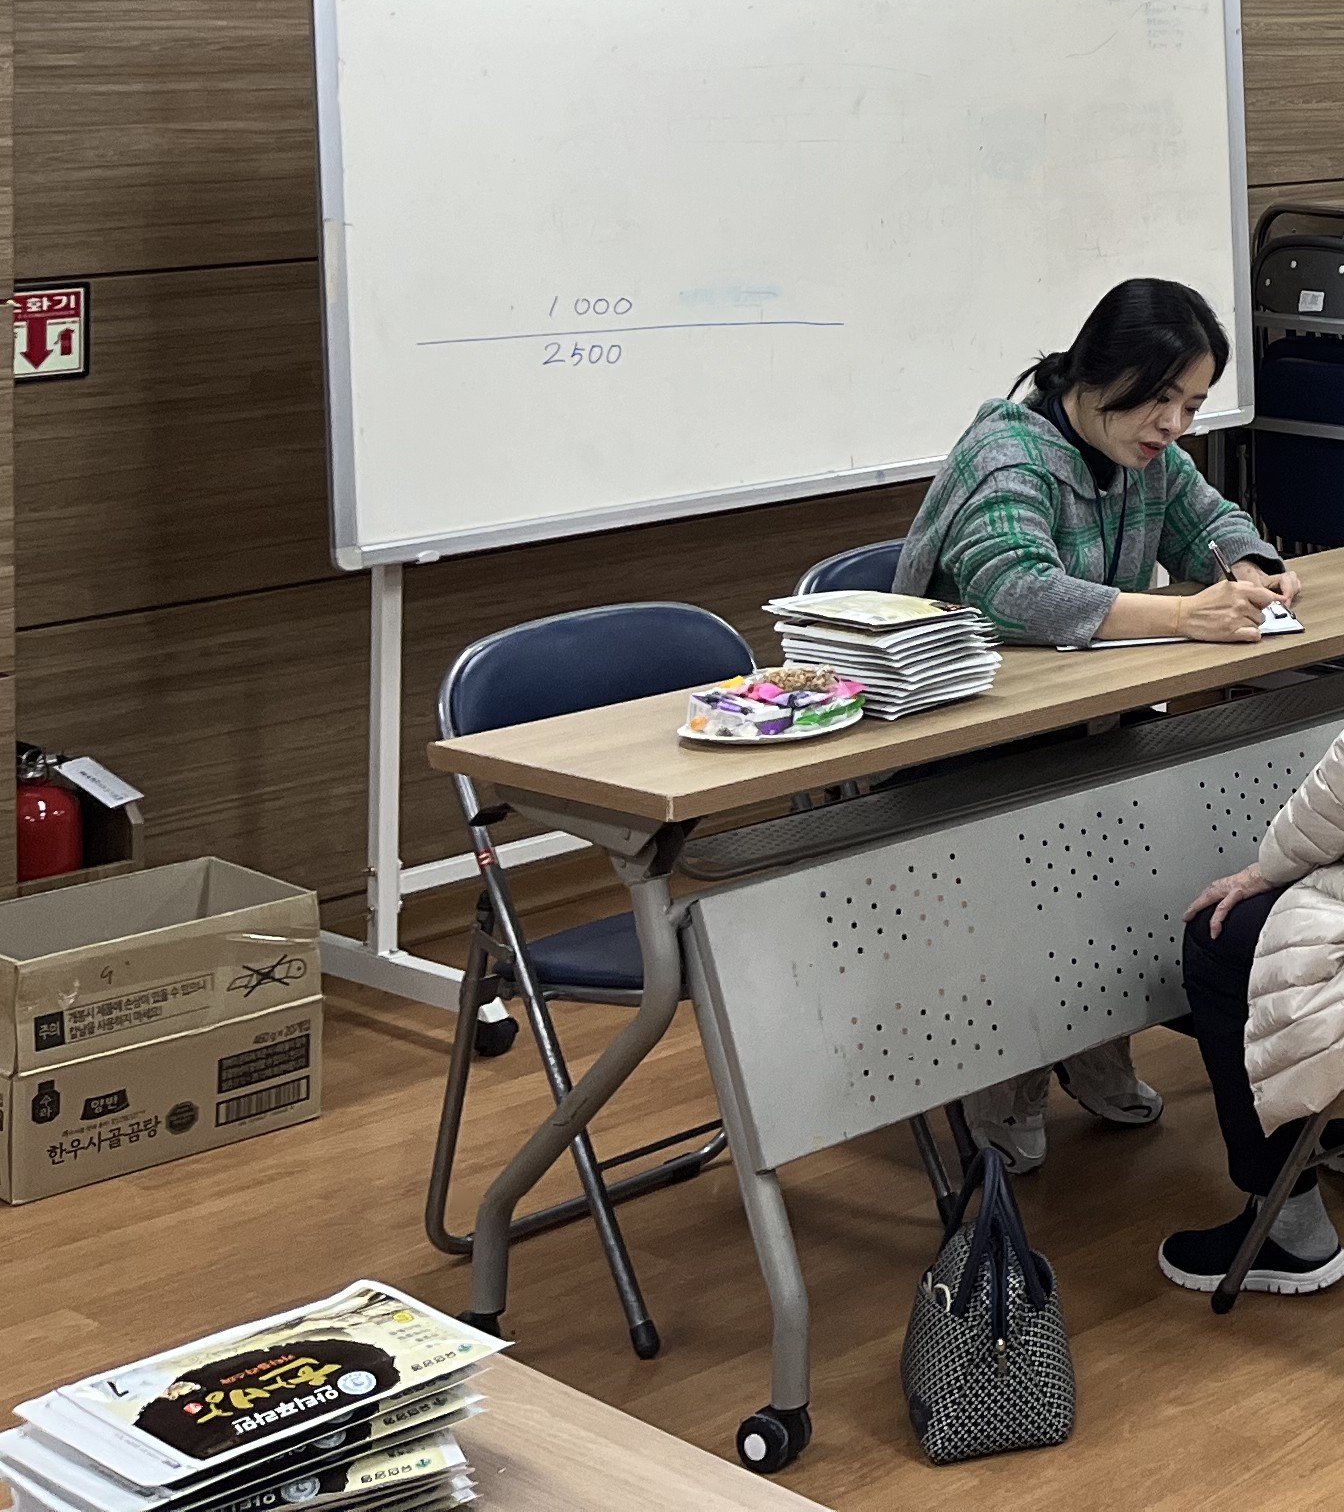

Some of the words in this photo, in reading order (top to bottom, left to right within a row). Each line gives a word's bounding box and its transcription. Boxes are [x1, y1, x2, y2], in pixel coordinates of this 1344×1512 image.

[548, 295, 633, 318] 1000
[542, 342, 623, 366] 2500
[38, 1021, 60, 1040] 주의
[90, 1095, 118, 1114] 양반
[46, 1115, 163, 1166] 한우사골곰탕
[231, 1385, 341, 1436] 안티푸라민
